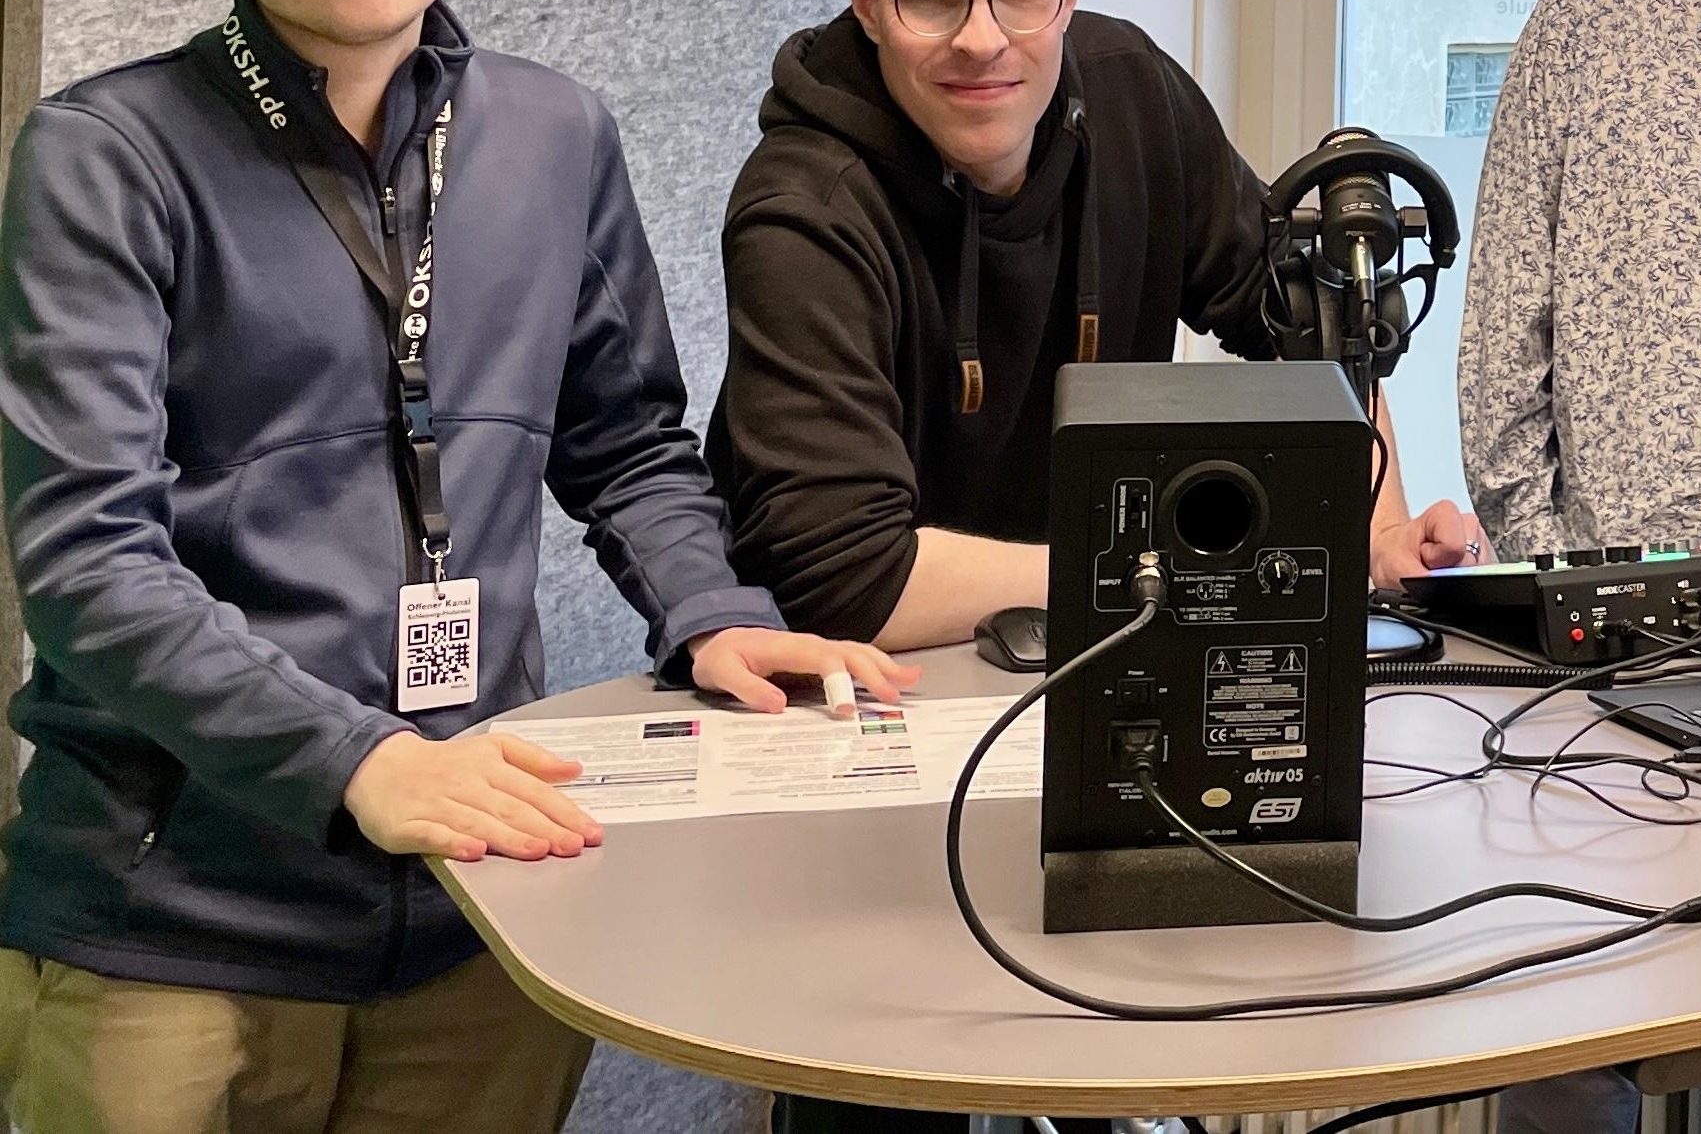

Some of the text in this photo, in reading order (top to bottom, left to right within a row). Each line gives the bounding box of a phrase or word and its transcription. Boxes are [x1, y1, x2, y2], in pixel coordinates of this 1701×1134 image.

[222, 15, 287, 130] OKSH.de
[1244, 767, 1304, 784] aktiv 05
